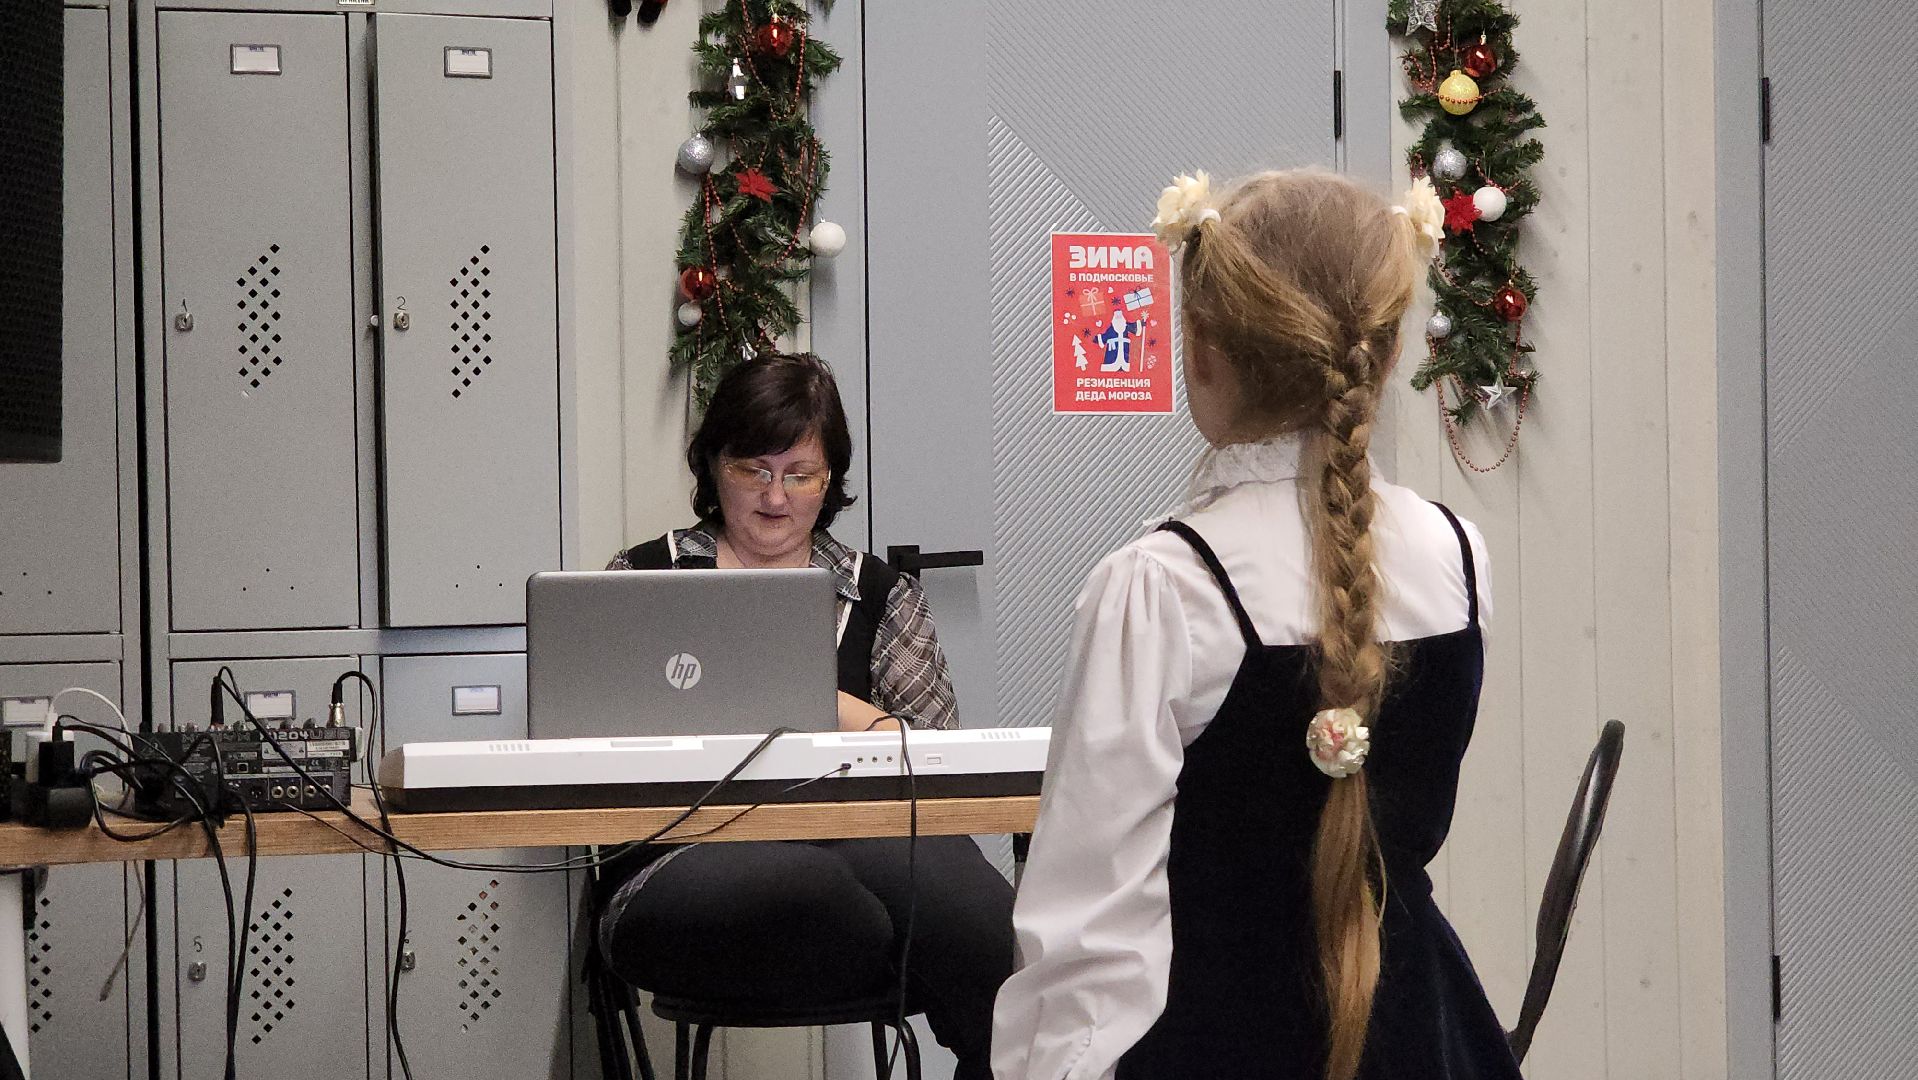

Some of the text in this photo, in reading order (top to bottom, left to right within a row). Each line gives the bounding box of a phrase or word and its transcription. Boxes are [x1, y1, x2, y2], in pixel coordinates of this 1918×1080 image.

[1069, 246, 1154, 269] ЗИМА
[1069, 273, 1154, 283] В ПОДМОСКОВЬЕ
[396, 295, 406, 311] 2
[1076, 378, 1151, 388] РЕЗИДЕНЦИЯ
[1075, 391, 1152, 401] ДЕДА МОРОЗА
[671, 653, 697, 690] hp
